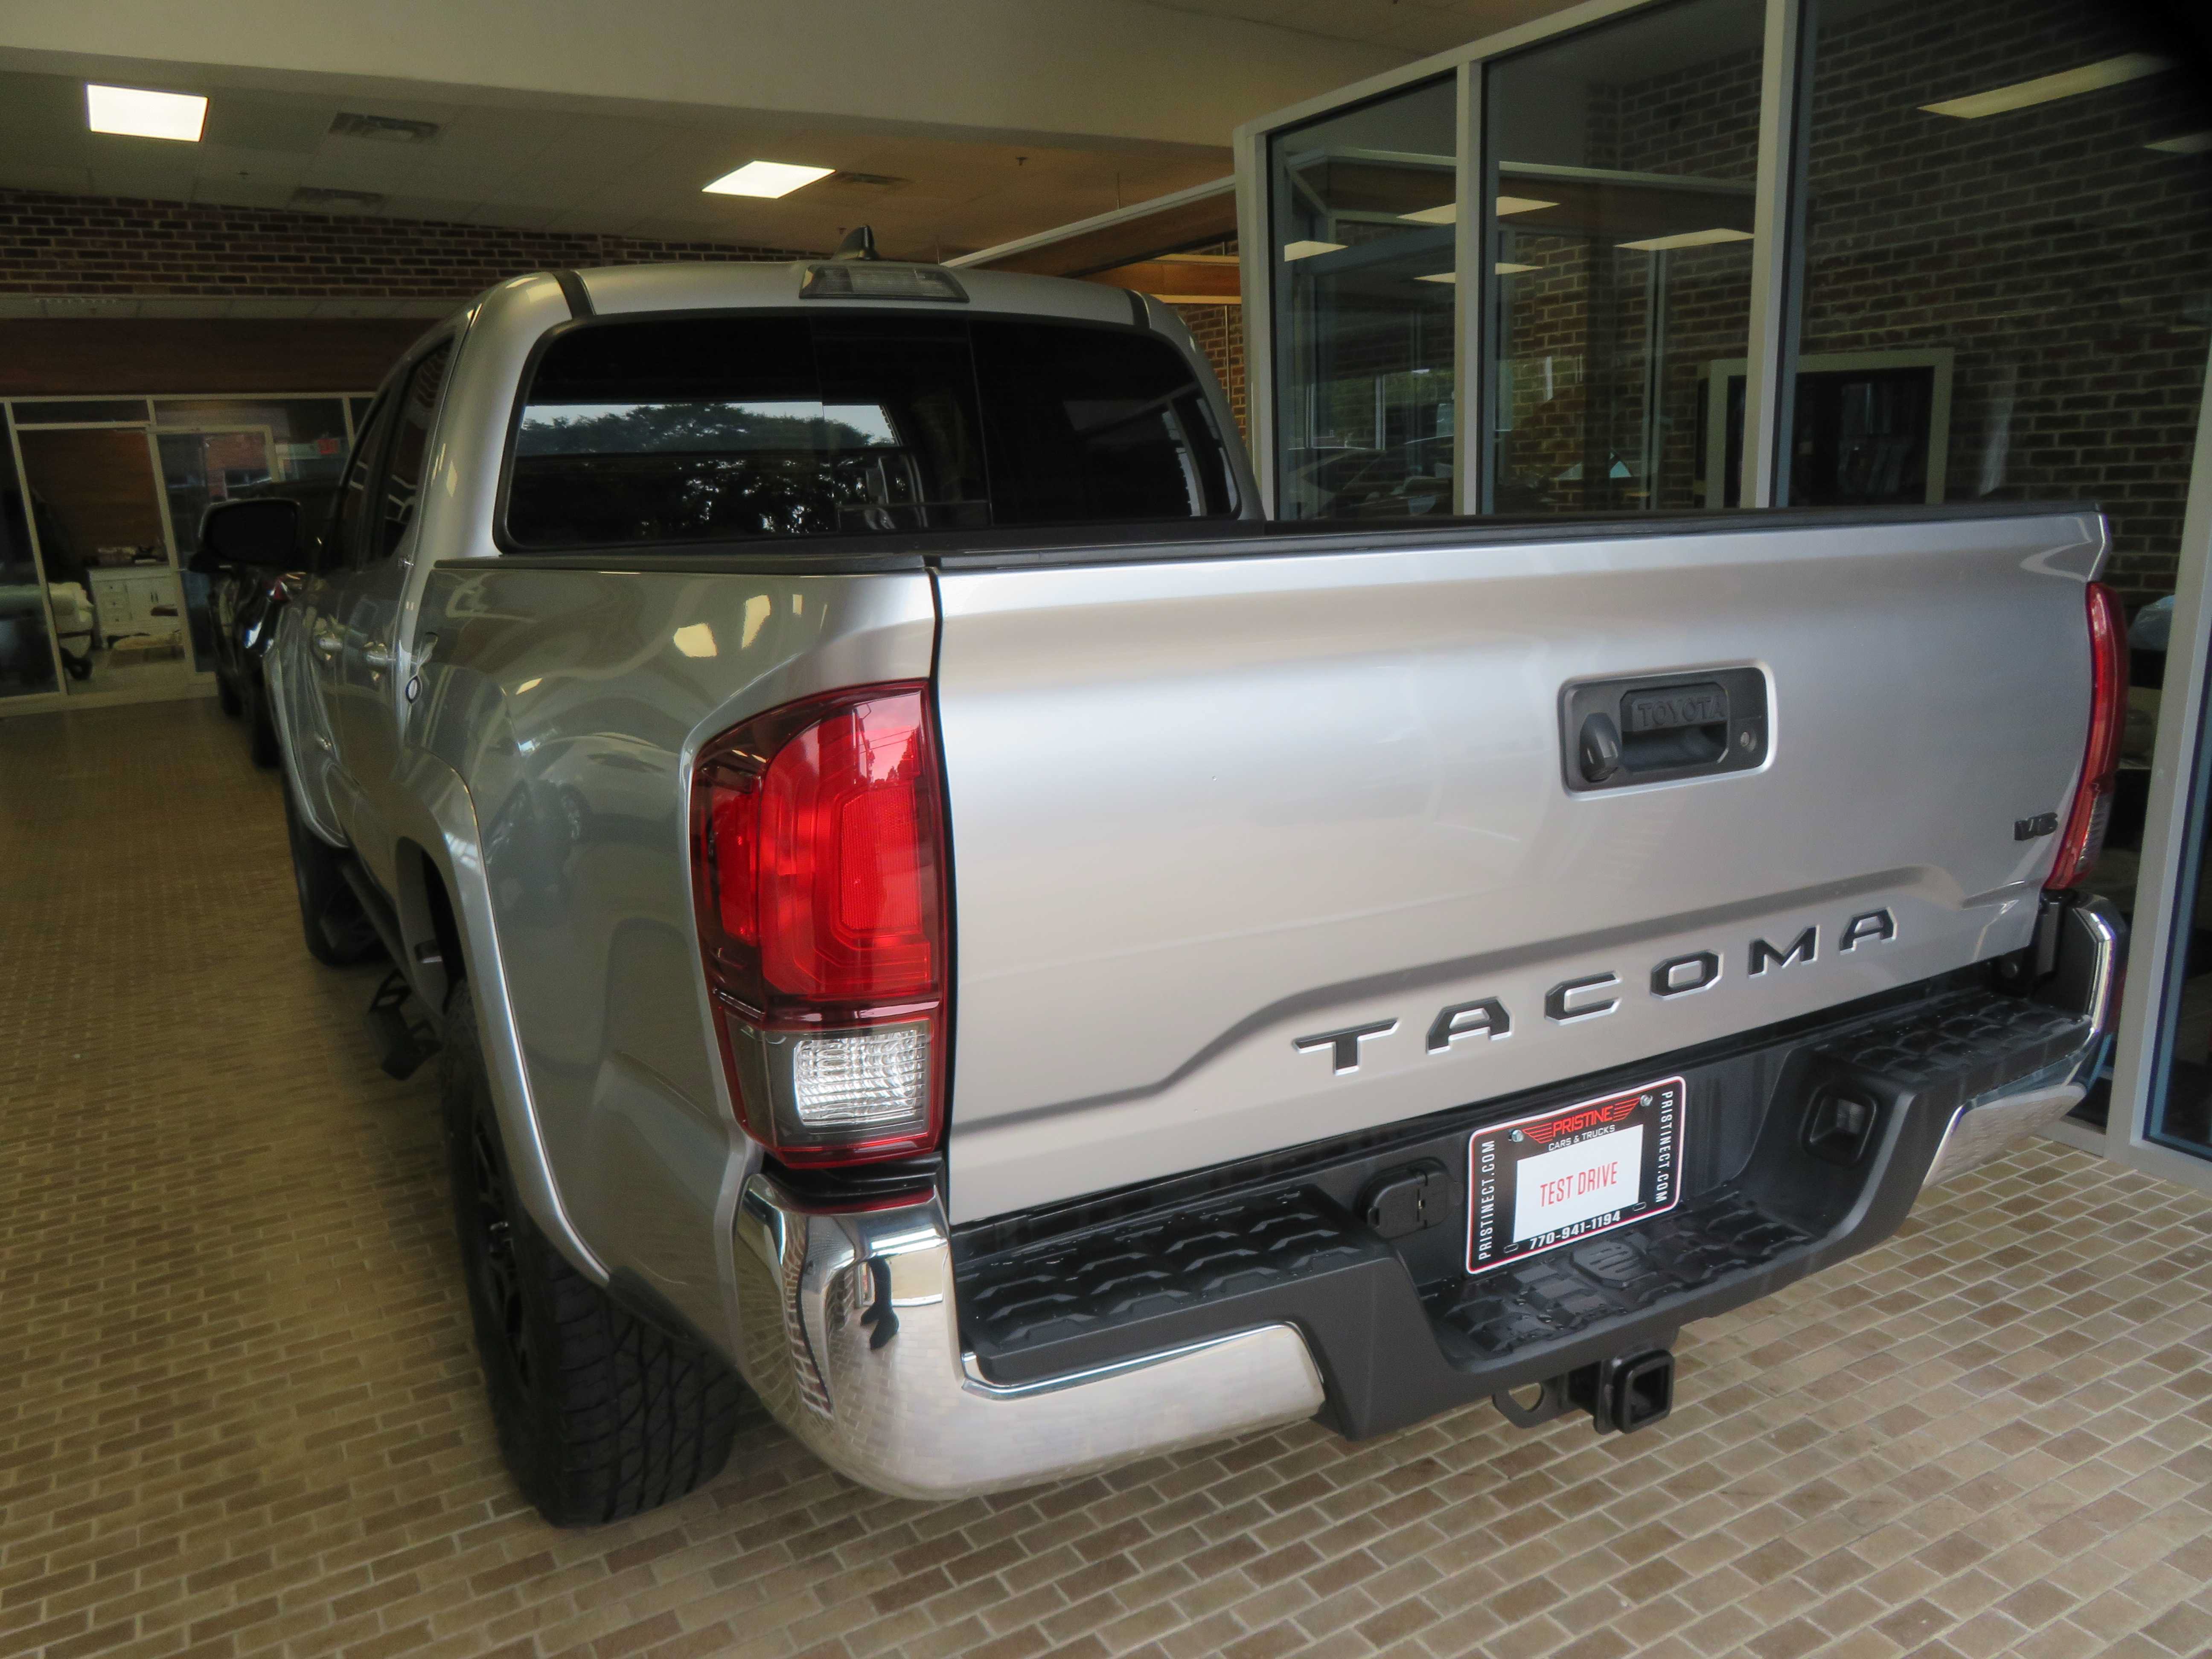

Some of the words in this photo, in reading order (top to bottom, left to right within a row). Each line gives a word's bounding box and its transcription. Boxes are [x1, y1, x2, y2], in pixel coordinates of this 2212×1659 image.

[1638, 696, 1727, 726] TOYOTA
[1292, 907, 1898, 1075] TACOMA
[1548, 1138, 1571, 1151] CARS
[1581, 1125, 1615, 1140] TRUCKS
[1552, 1106, 1613, 1137] PRISTINE
[1656, 1091, 1674, 1203] PRISTINECT.COM
[1479, 1140, 1495, 1260] PRISTINECT.COM
[1540, 1175, 1574, 1207] TEST
[1578, 1161, 1618, 1196] DRIVE
[1529, 1211, 1621, 1249] 770-941-1194
